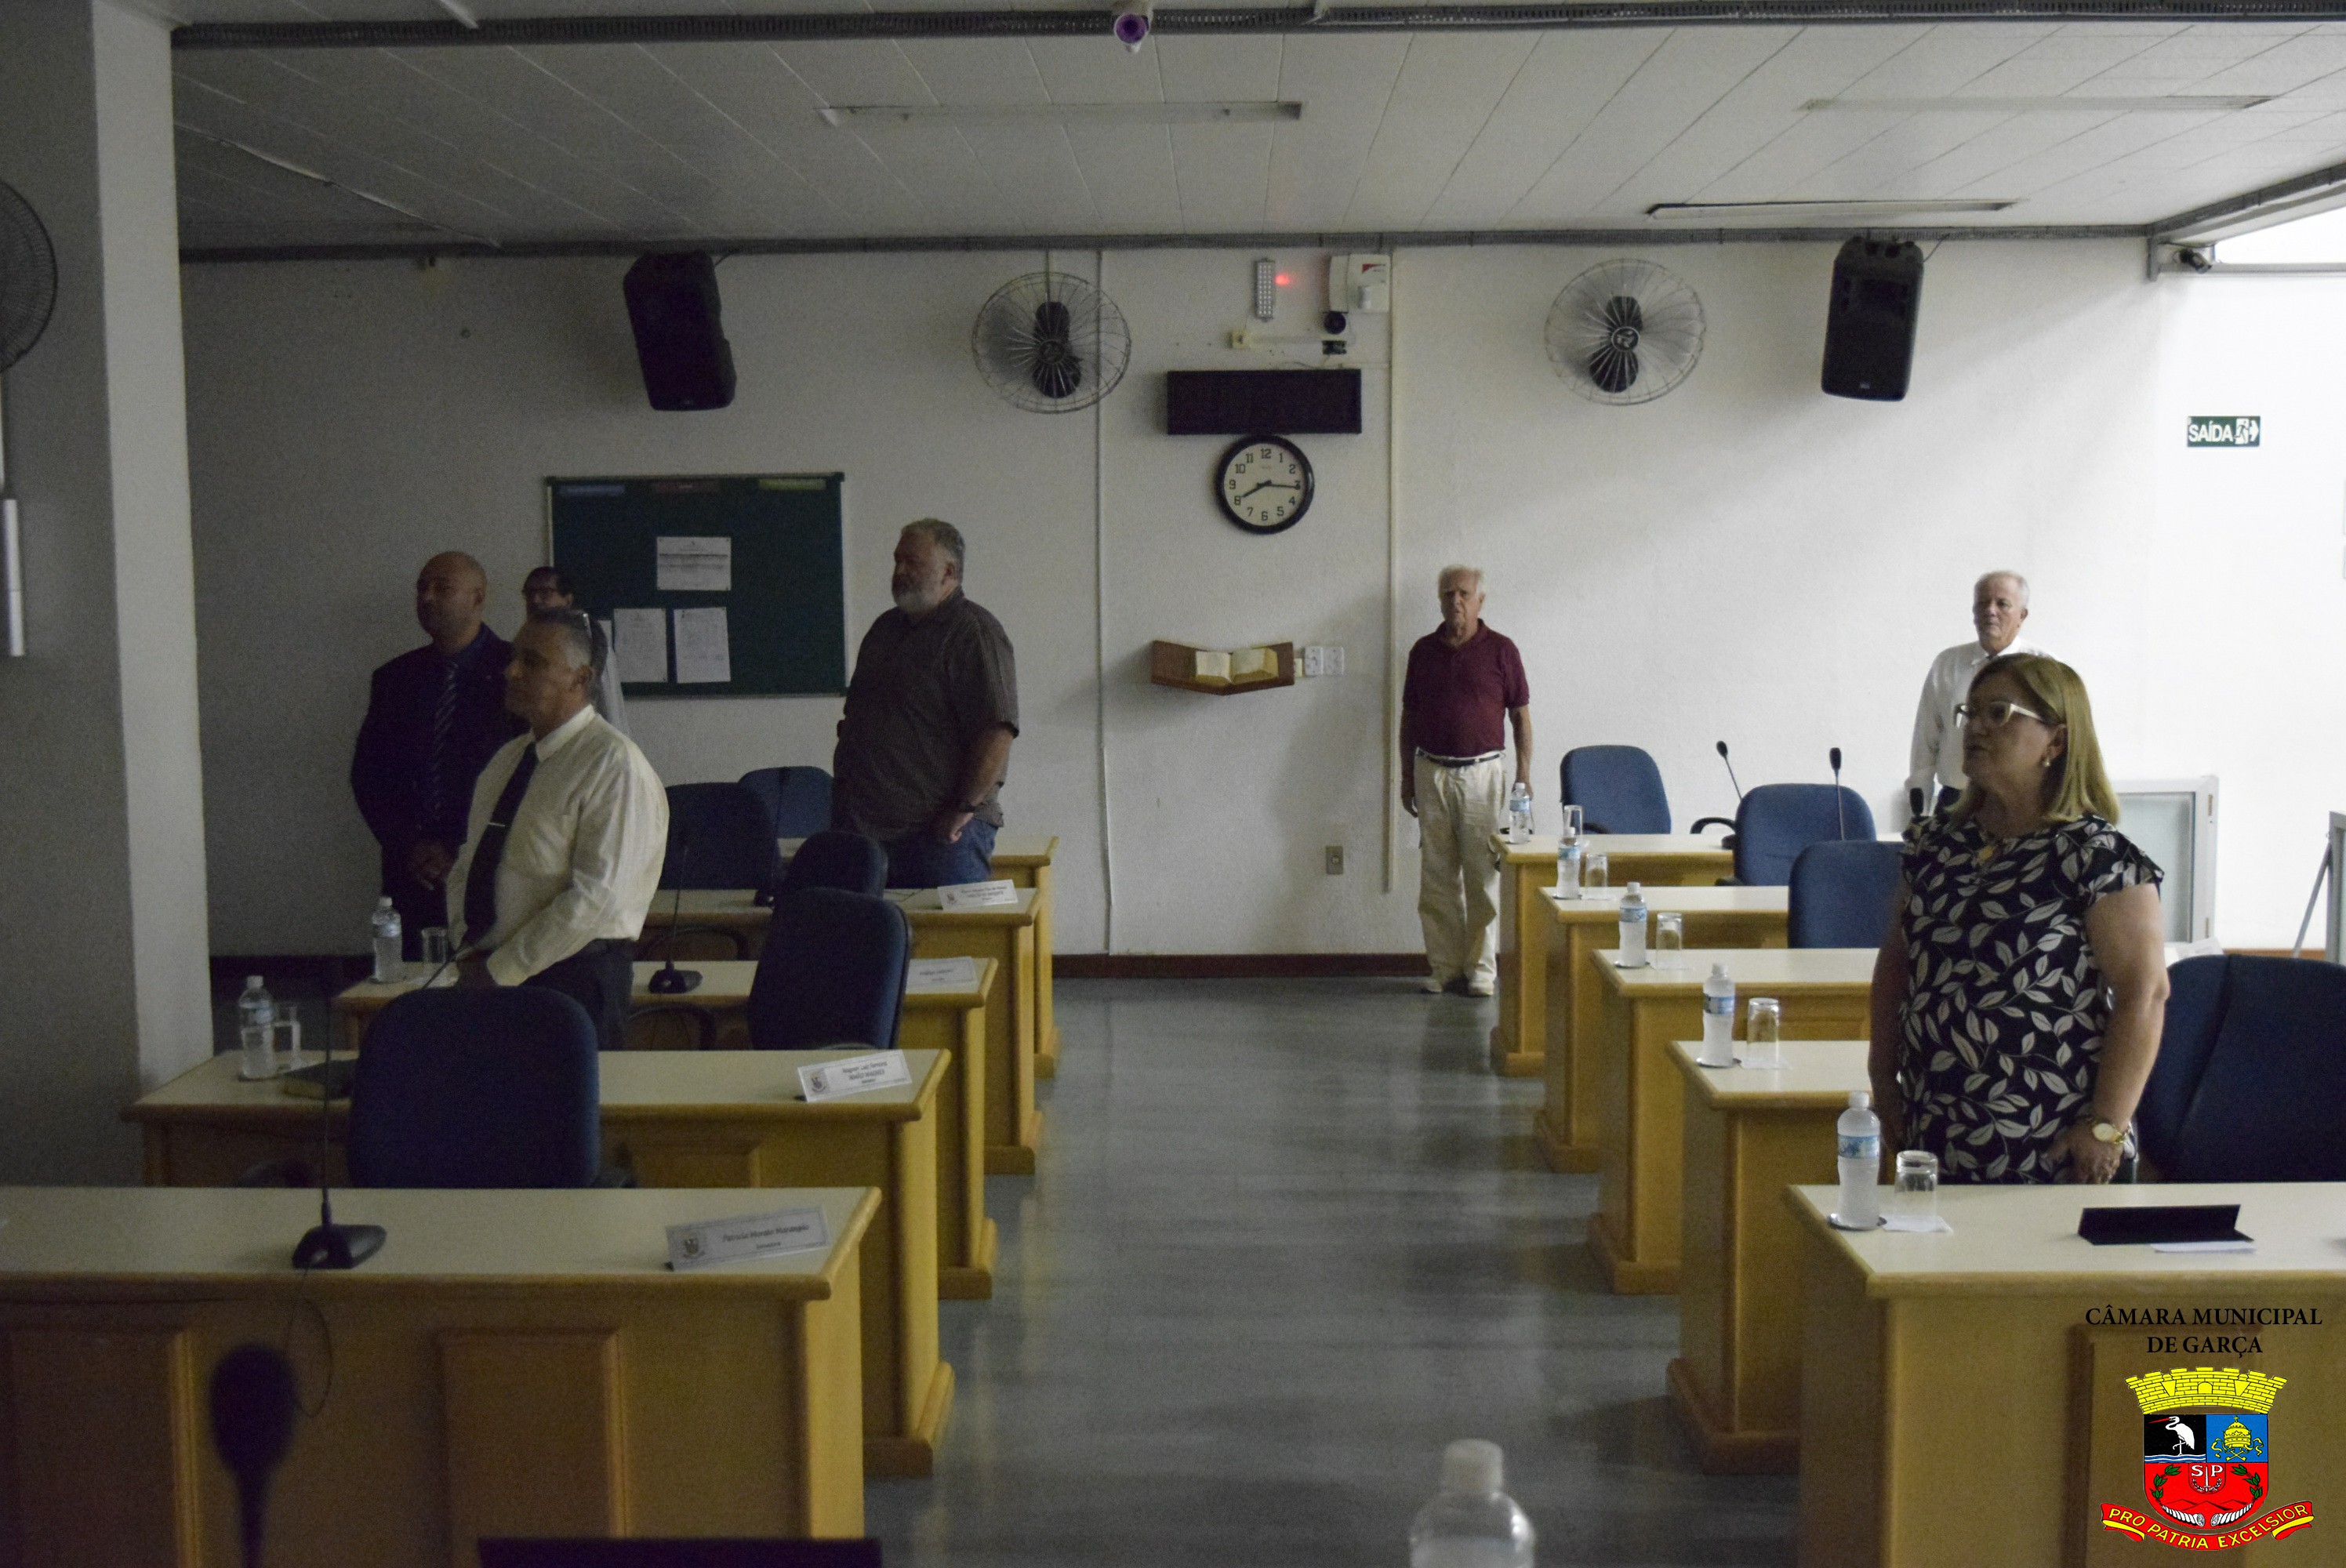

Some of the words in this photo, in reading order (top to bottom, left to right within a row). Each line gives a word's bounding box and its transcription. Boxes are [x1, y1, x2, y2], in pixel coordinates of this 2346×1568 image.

[2188, 419, 2233, 442] SAÍDA
[1246, 454, 1253, 463] 11
[1261, 449, 1271, 459] 12
[1279, 453, 1284, 463] 1
[1235, 464, 1245, 474] 10
[1289, 464, 1295, 474] 2
[1229, 480, 1236, 489] 9
[1295, 481, 1301, 490] 3
[1234, 496, 1240, 505] 8
[1289, 497, 1295, 506] 4
[1247, 507, 1253, 517] 7
[1262, 511, 1268, 521] 6
[1277, 506, 1284, 516] 5
